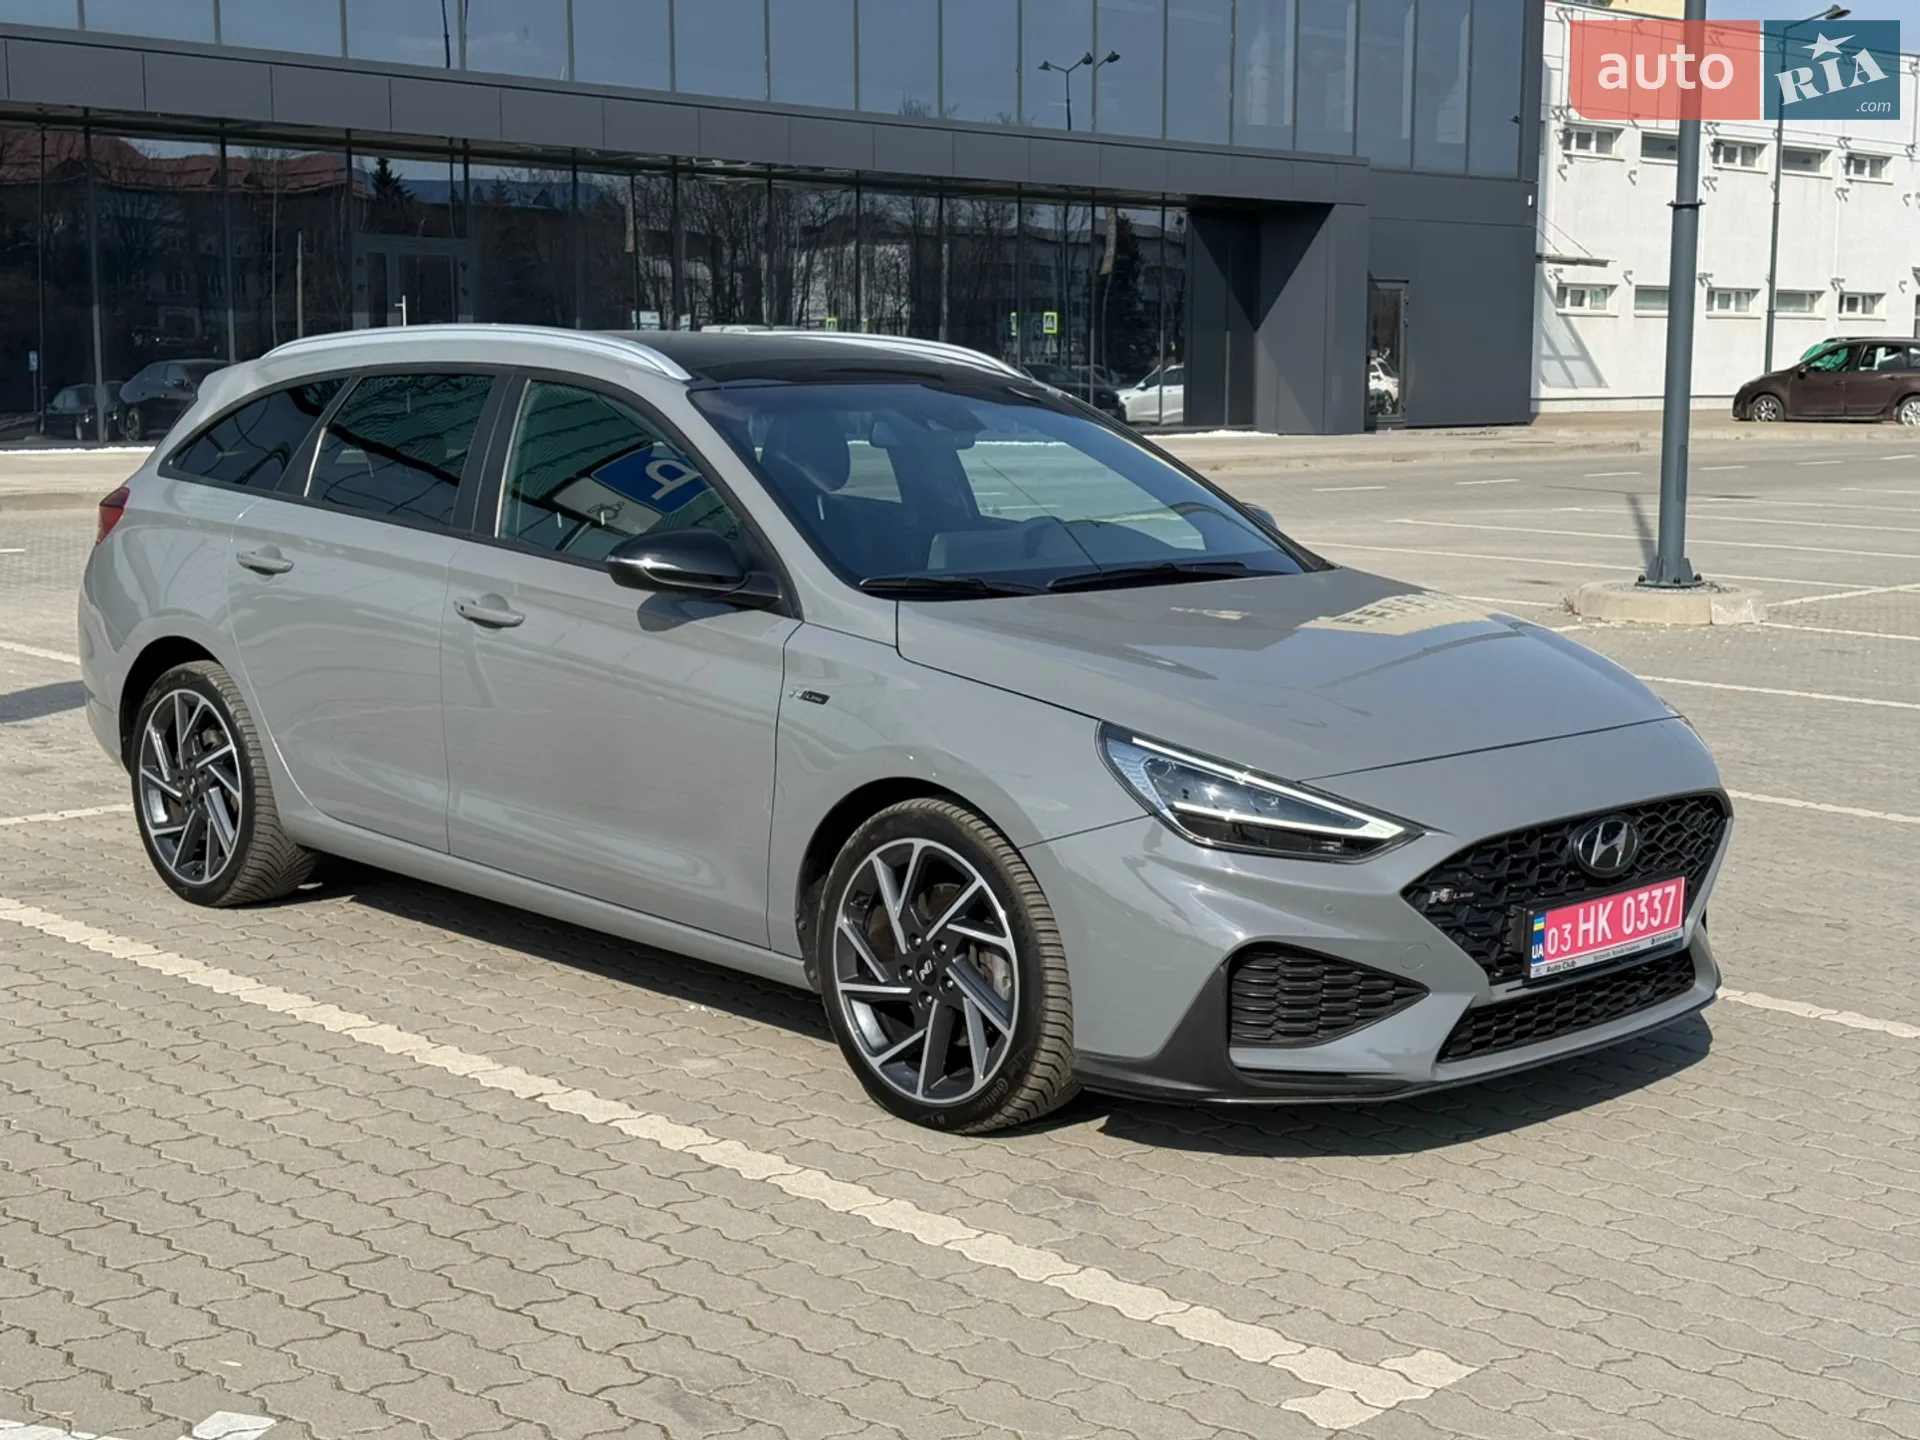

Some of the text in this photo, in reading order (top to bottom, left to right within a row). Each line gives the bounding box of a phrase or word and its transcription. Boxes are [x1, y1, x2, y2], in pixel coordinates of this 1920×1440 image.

[1547, 885, 1677, 955] 03 HK 0337
[1532, 945, 1544, 959] UA
[1546, 959, 1577, 973] Auto Club
